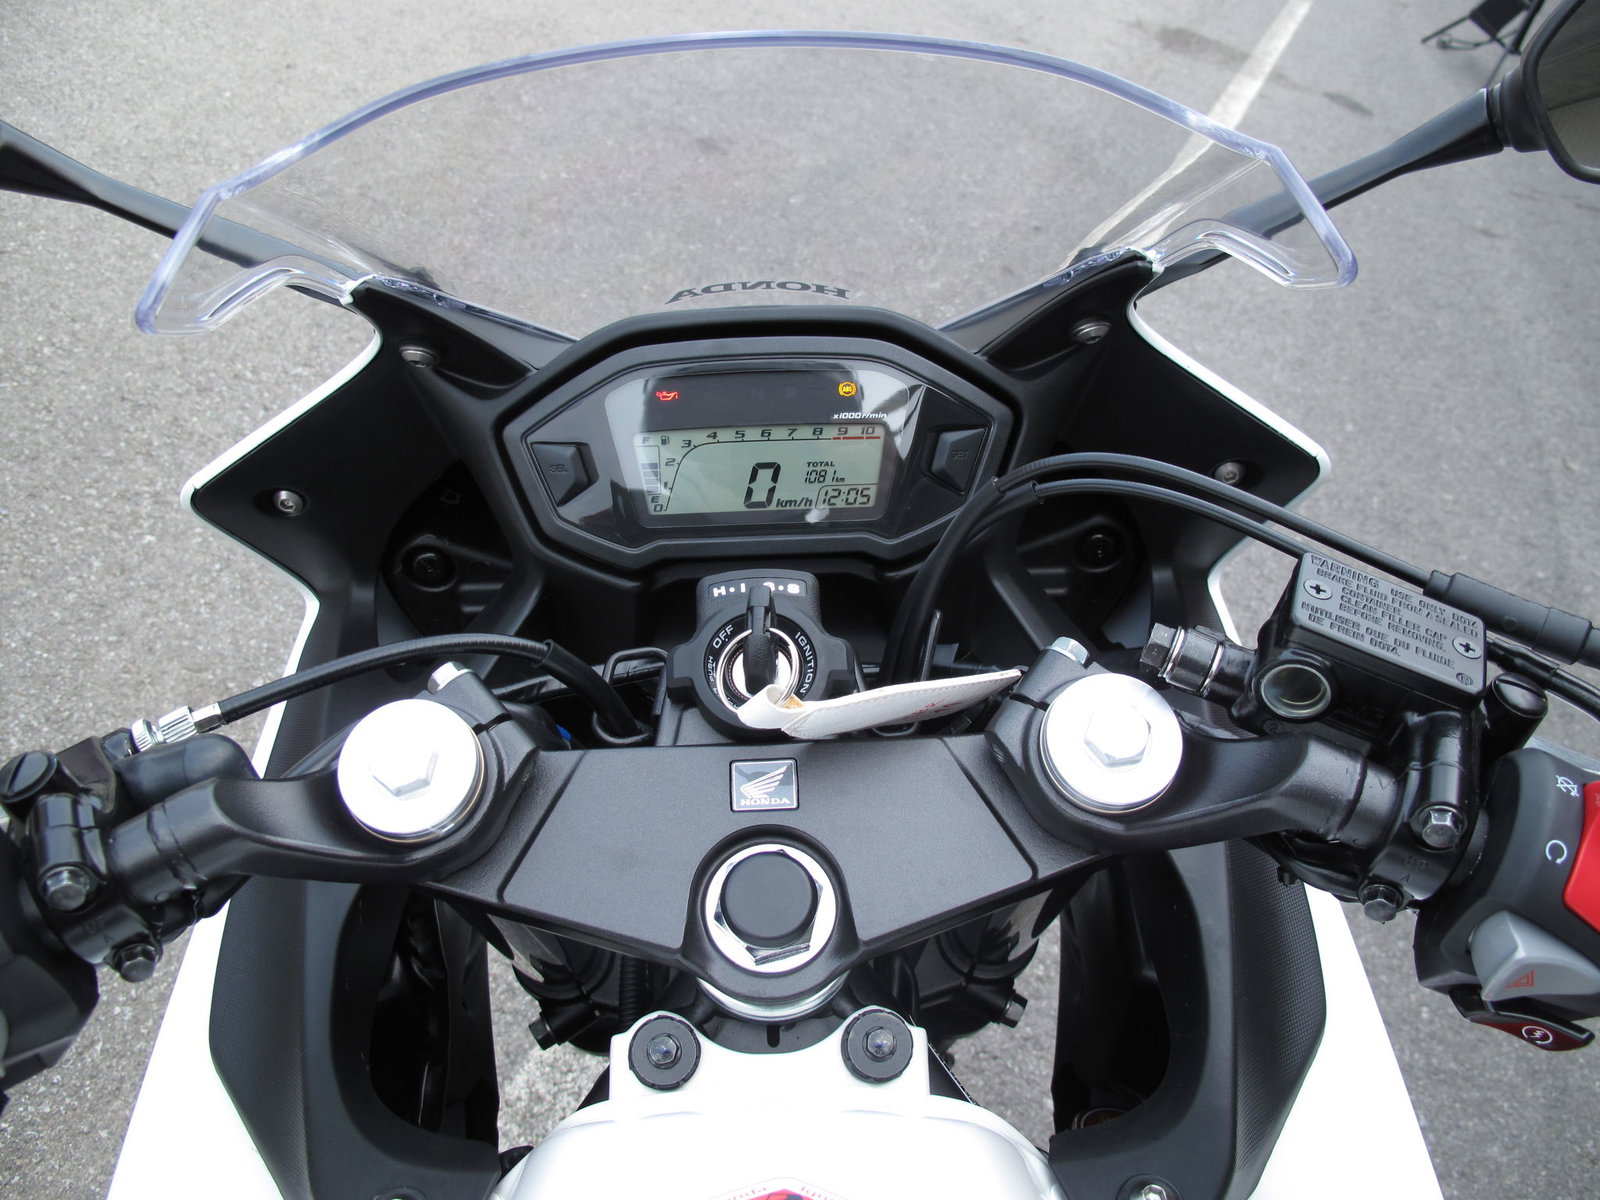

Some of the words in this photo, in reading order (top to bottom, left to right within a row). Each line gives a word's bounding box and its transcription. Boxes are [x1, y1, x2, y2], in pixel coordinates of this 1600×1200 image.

[642, 436, 651, 444] F
[681, 439, 692, 448] 3
[706, 431, 718, 440] 4
[734, 430, 746, 439] 5
[761, 428, 772, 438] 6
[787, 428, 797, 437] 7
[812, 427, 823, 436] 8
[837, 426, 848, 436] 9
[861, 426, 876, 435] 10
[665, 457, 676, 466] 2
[743, 461, 781, 509] 0
[823, 487, 871, 506] 12:05
[776, 497, 813, 508] km/h
[1311, 554, 1379, 589] WARNING
[1390, 588, 1413, 603] USE
[1418, 599, 1446, 616] ONLY
[1316, 568, 1353, 588] BRAKE
[1356, 583, 1388, 601] FLUID
[1391, 597, 1423, 615] FROM
[1435, 614, 1479, 638] SEALED
[1339, 603, 1383, 626] BEFORE
[1308, 613, 1325, 626] DE
[1329, 621, 1365, 642] FREIN
[1340, 594, 1378, 615] CLEAN
[1381, 610, 1421, 631] FILLER
[1425, 627, 1447, 641] CAP
[712, 624, 734, 649] OFF
[794, 631, 815, 693] IGNITION
[1393, 637, 1410, 650] DU
[1415, 646, 1455, 669] FLUIDE
[740, 797, 792, 807] HONDA
